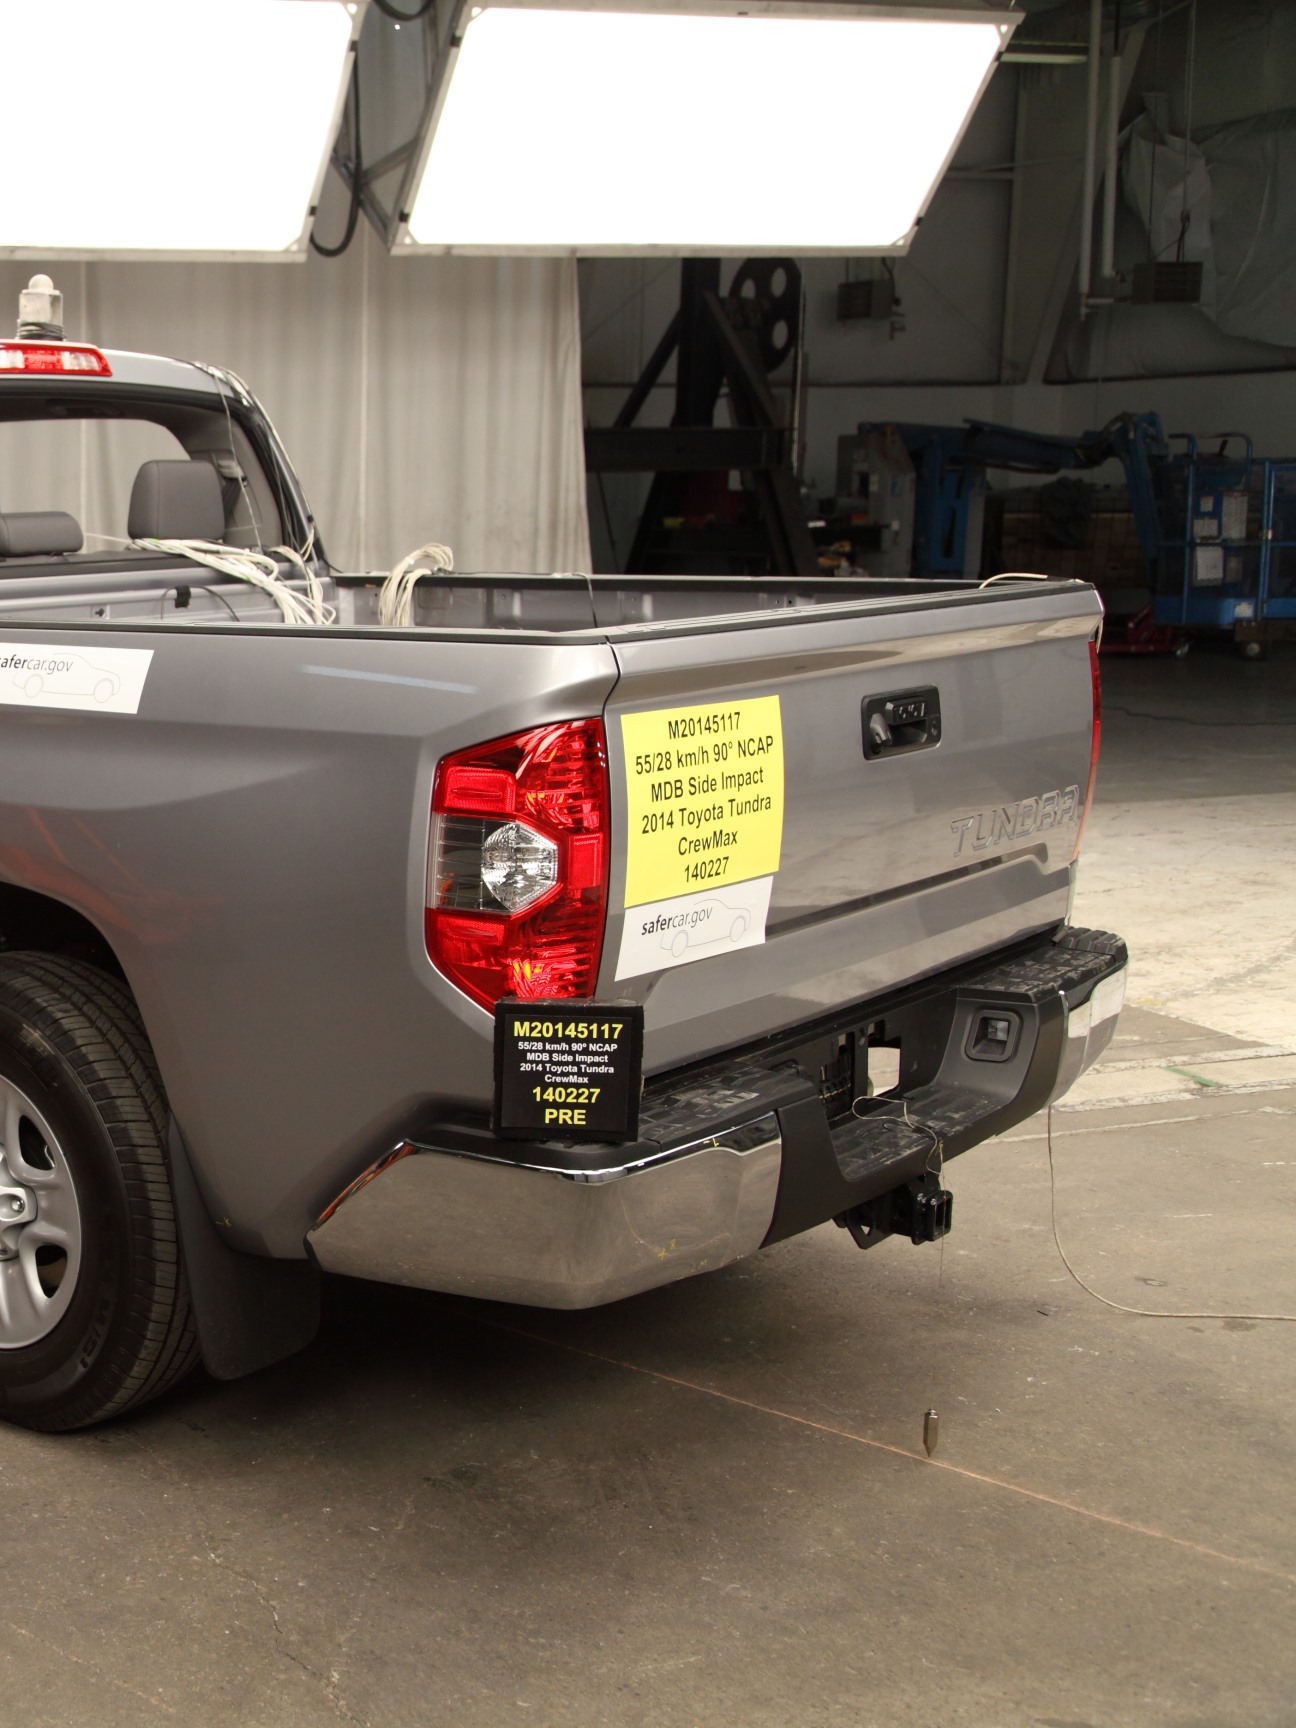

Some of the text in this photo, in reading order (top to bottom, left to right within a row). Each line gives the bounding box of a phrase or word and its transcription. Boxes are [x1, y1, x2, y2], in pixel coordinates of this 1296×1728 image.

[668, 712, 741, 740] M20145117
[635, 751, 672, 775] 55/28
[677, 746, 709, 769] km/h
[737, 735, 774, 758] NCAP
[651, 766, 764, 803] MDB Side Impact
[641, 794, 771, 835] 2014 Toyota Tundra
[950, 784, 1080, 857] TUNDRA
[678, 829, 738, 856] CrewMax
[684, 856, 730, 883] 140227
[641, 906, 713, 936] safercar.gov
[513, 1021, 623, 1039] M20145117
[518, 1042, 544, 1051] 55/28
[545, 1042, 569, 1051] km/h
[589, 1043, 618, 1052] NCAP
[526, 1052, 609, 1064] MDB Side Impact
[520, 1063, 615, 1074] 2014 Toyota Tundra
[544, 1074, 589, 1084] CrewMax
[532, 1086, 601, 1104] 140227
[544, 1108, 587, 1125] PRE
